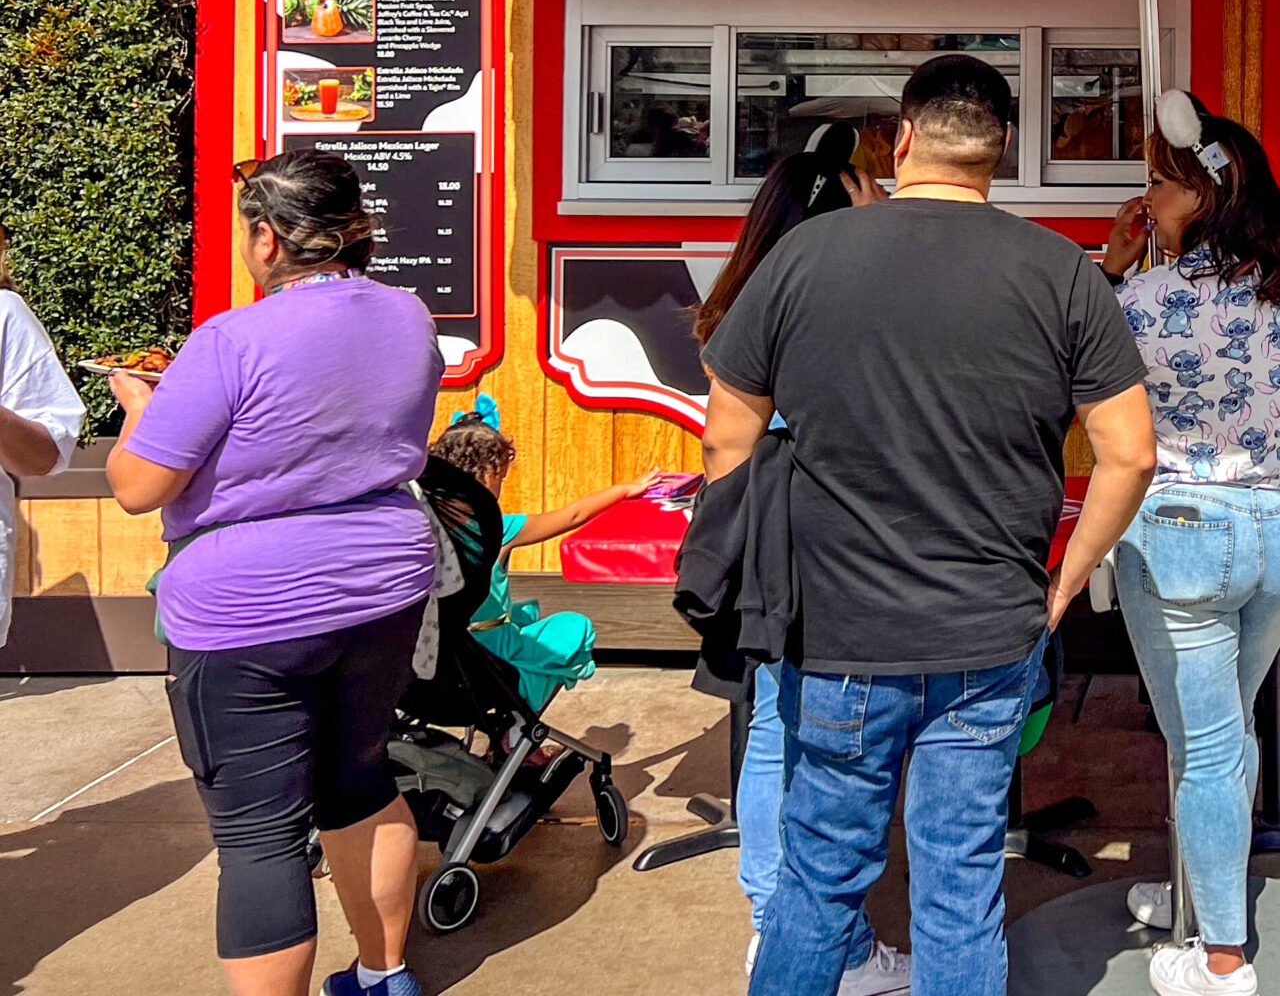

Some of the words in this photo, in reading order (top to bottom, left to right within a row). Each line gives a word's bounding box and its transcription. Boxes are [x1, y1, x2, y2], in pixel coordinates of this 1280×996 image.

[315, 142, 347, 150] Estrella
[349, 142, 377, 150] Jalisco
[379, 142, 413, 150] Mexican
[415, 142, 439, 151] Lager
[344, 152, 372, 161] Mexico
[374, 152, 391, 161] ABV
[367, 163, 389, 171] 14.50
[371, 257, 398, 266] Tropical
[400, 257, 417, 266] Hazy
